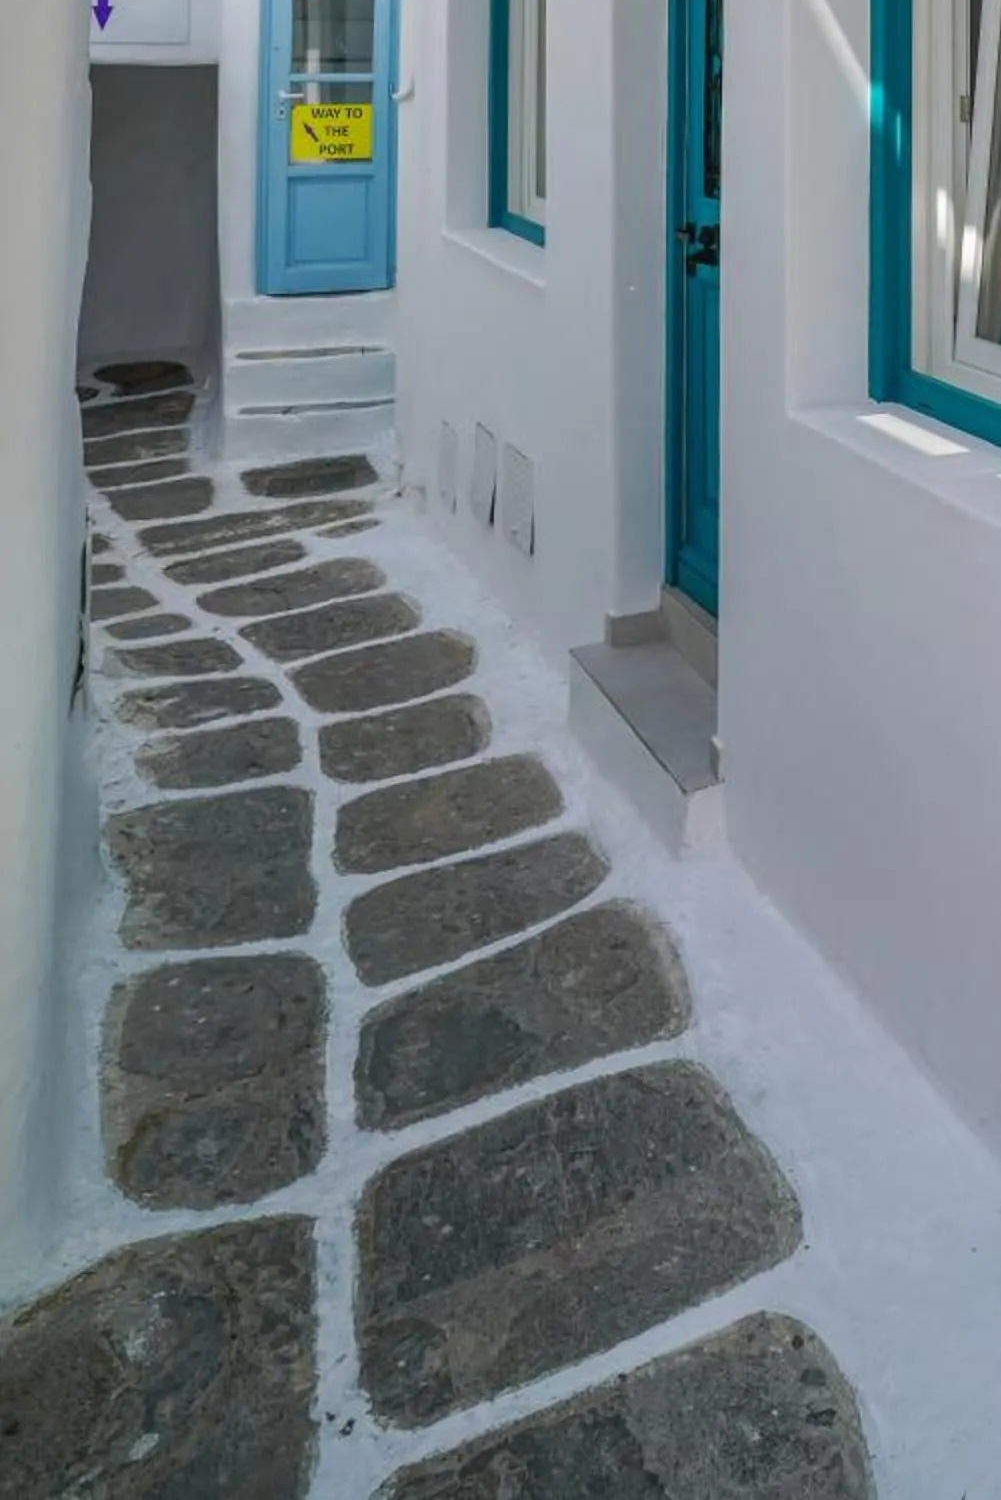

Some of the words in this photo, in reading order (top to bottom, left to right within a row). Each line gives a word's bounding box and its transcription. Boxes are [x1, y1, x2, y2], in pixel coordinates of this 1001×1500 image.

[312, 107, 340, 118] WAY
[345, 107, 363, 118] TO
[325, 125, 349, 137] THE
[319, 143, 355, 155] PORT
